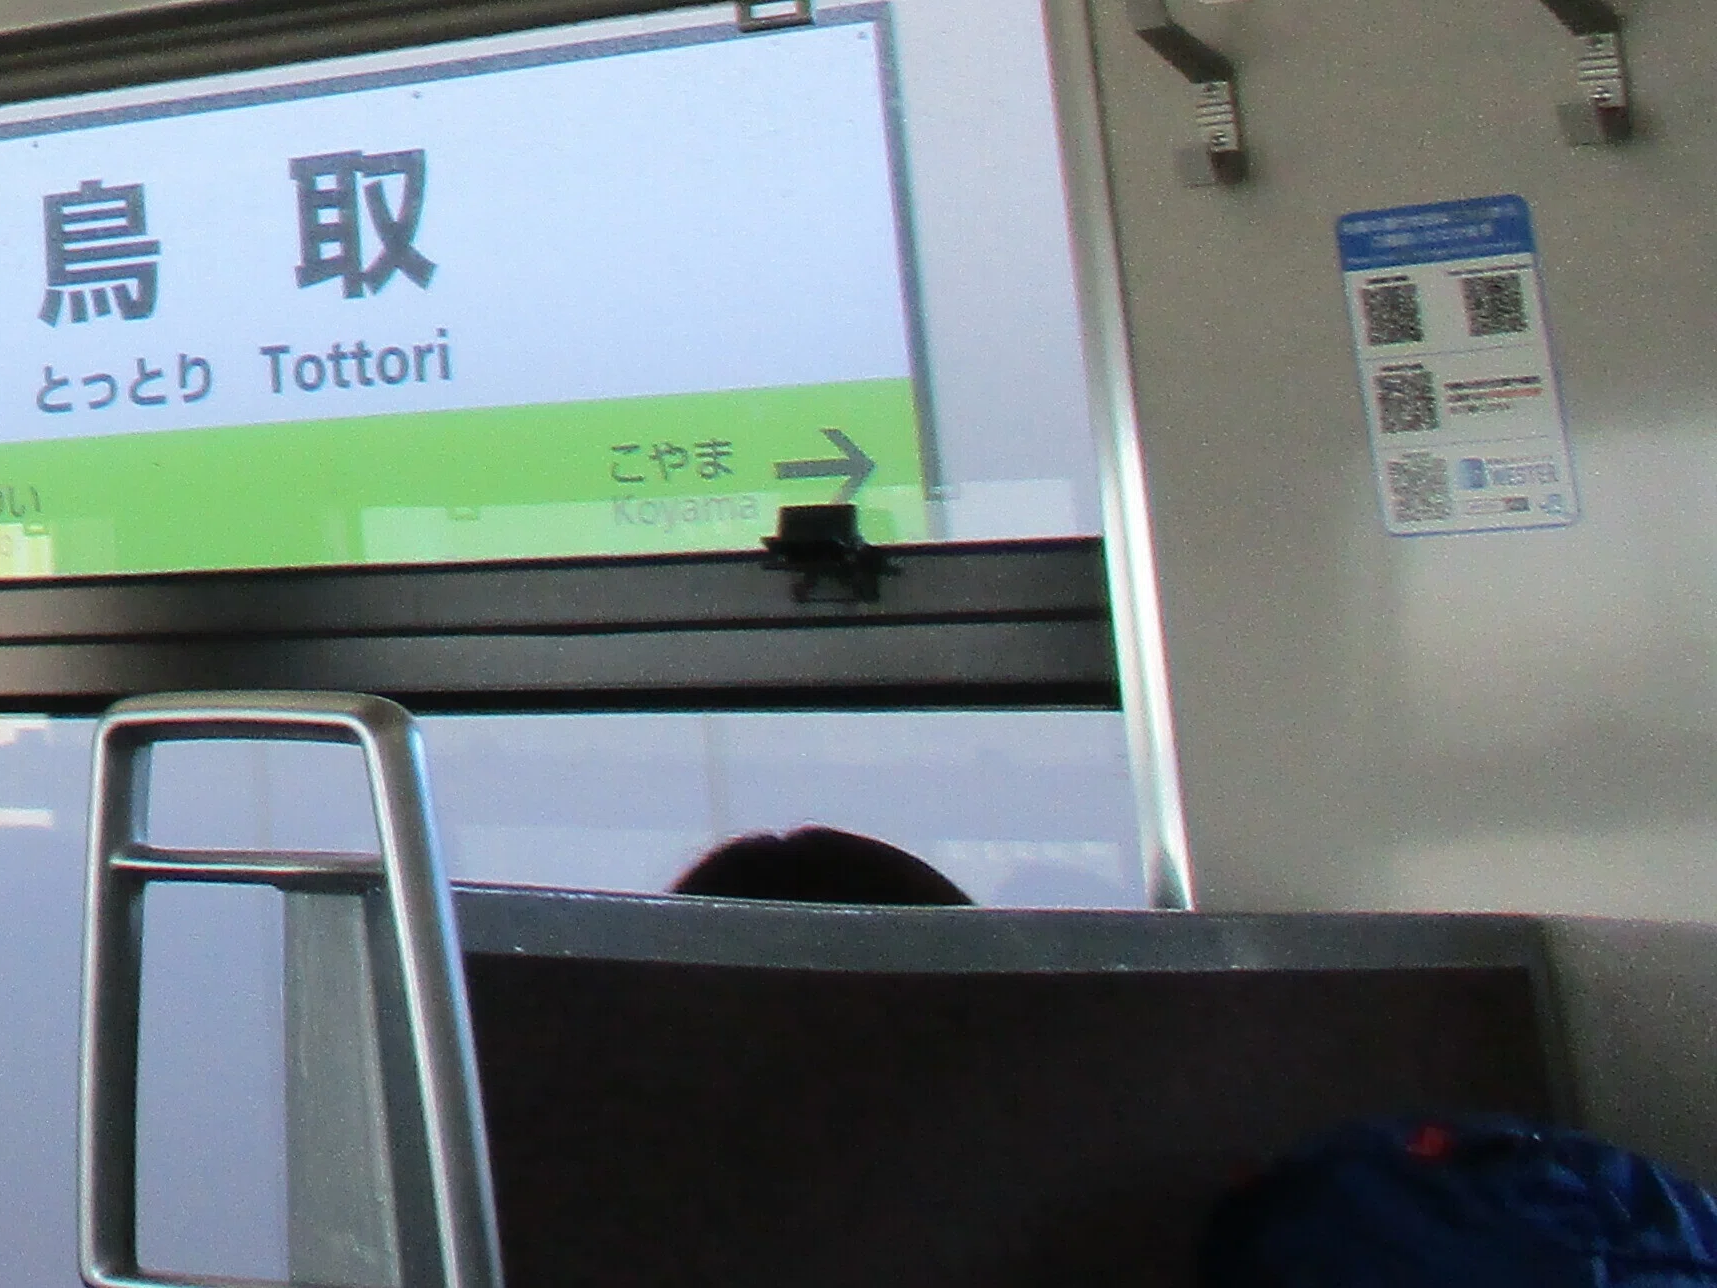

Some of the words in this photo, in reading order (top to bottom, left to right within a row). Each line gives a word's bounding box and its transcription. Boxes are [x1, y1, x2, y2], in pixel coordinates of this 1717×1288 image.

[37, 148, 438, 328] 鳥取
[35, 352, 213, 414] とっとり
[260, 327, 452, 394] Tottori
[610, 437, 734, 485] こやま
[612, 491, 759, 533] Koyama
